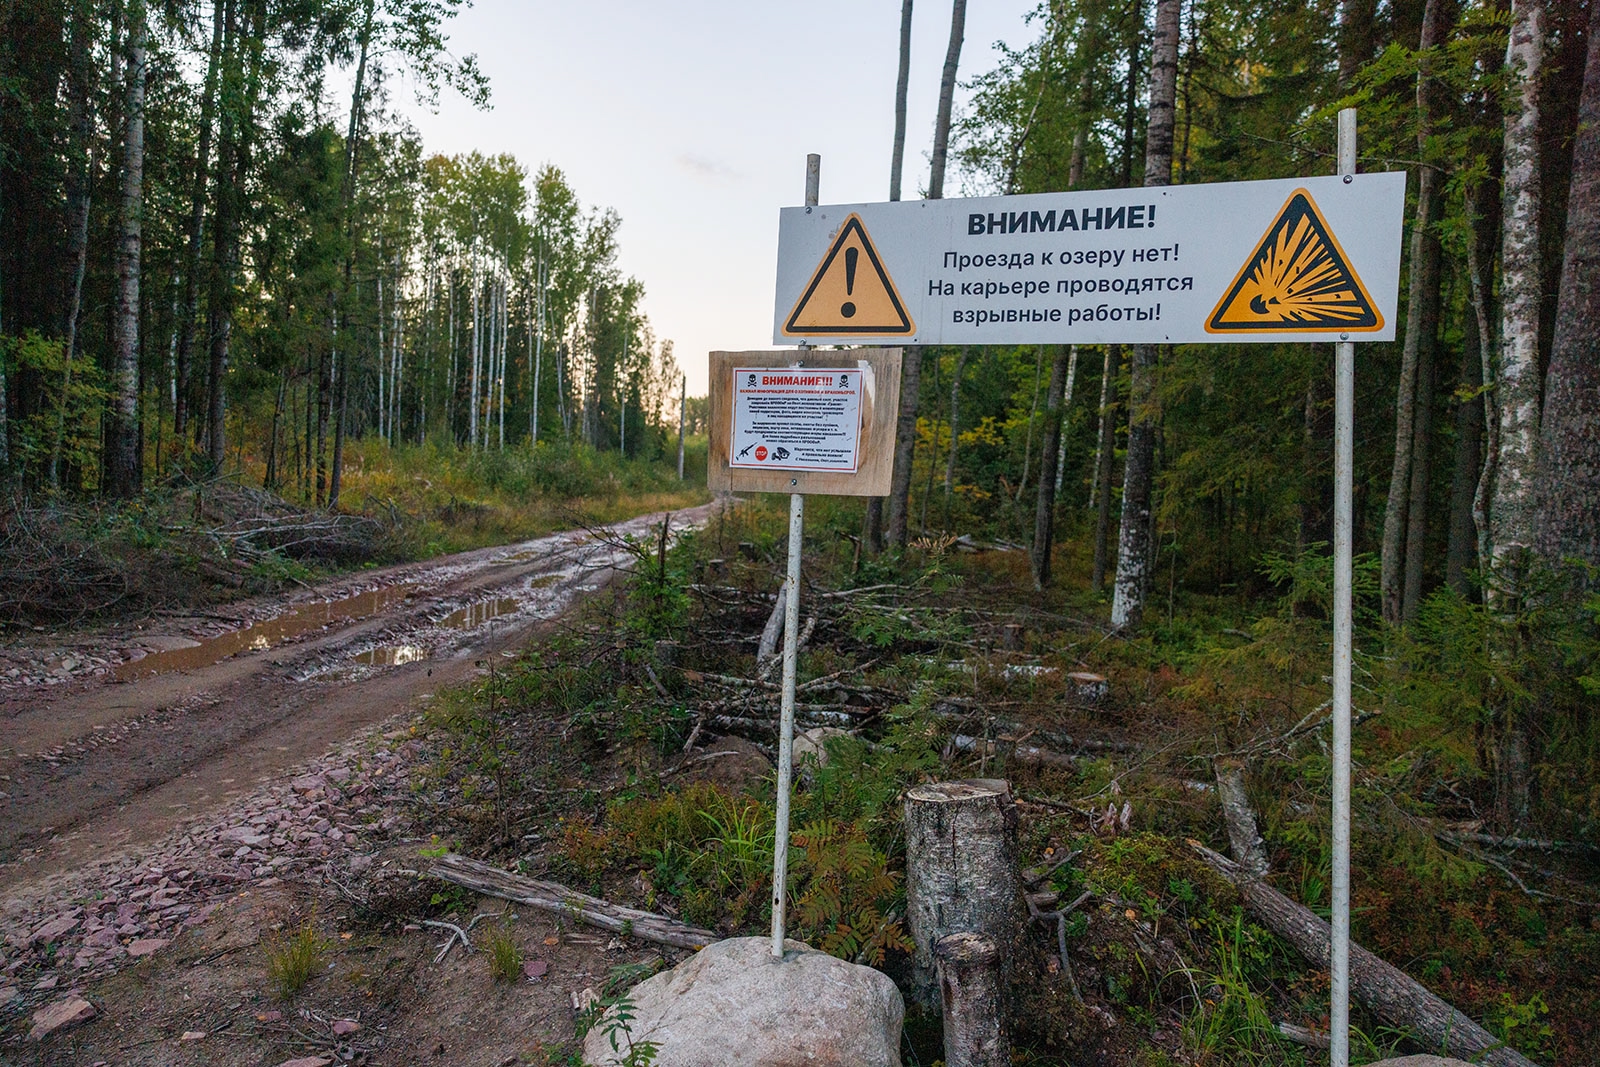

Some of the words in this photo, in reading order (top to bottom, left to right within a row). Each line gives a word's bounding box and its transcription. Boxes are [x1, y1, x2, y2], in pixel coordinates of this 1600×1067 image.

[968, 205, 1157, 236] ВНИМАНИЕ!
[943, 251, 1035, 272] Проезда
[1041, 251, 1053, 265] к
[1059, 249, 1126, 268] озеру
[1132, 243, 1180, 262] нет!
[928, 279, 955, 296] На
[961, 280, 1051, 299] карьере
[1056, 276, 1194, 298] проводятся
[953, 308, 1062, 327] взрывные
[1068, 303, 1162, 326] работы!
[762, 376, 833, 386] ВНИМАНИЕ!!!
